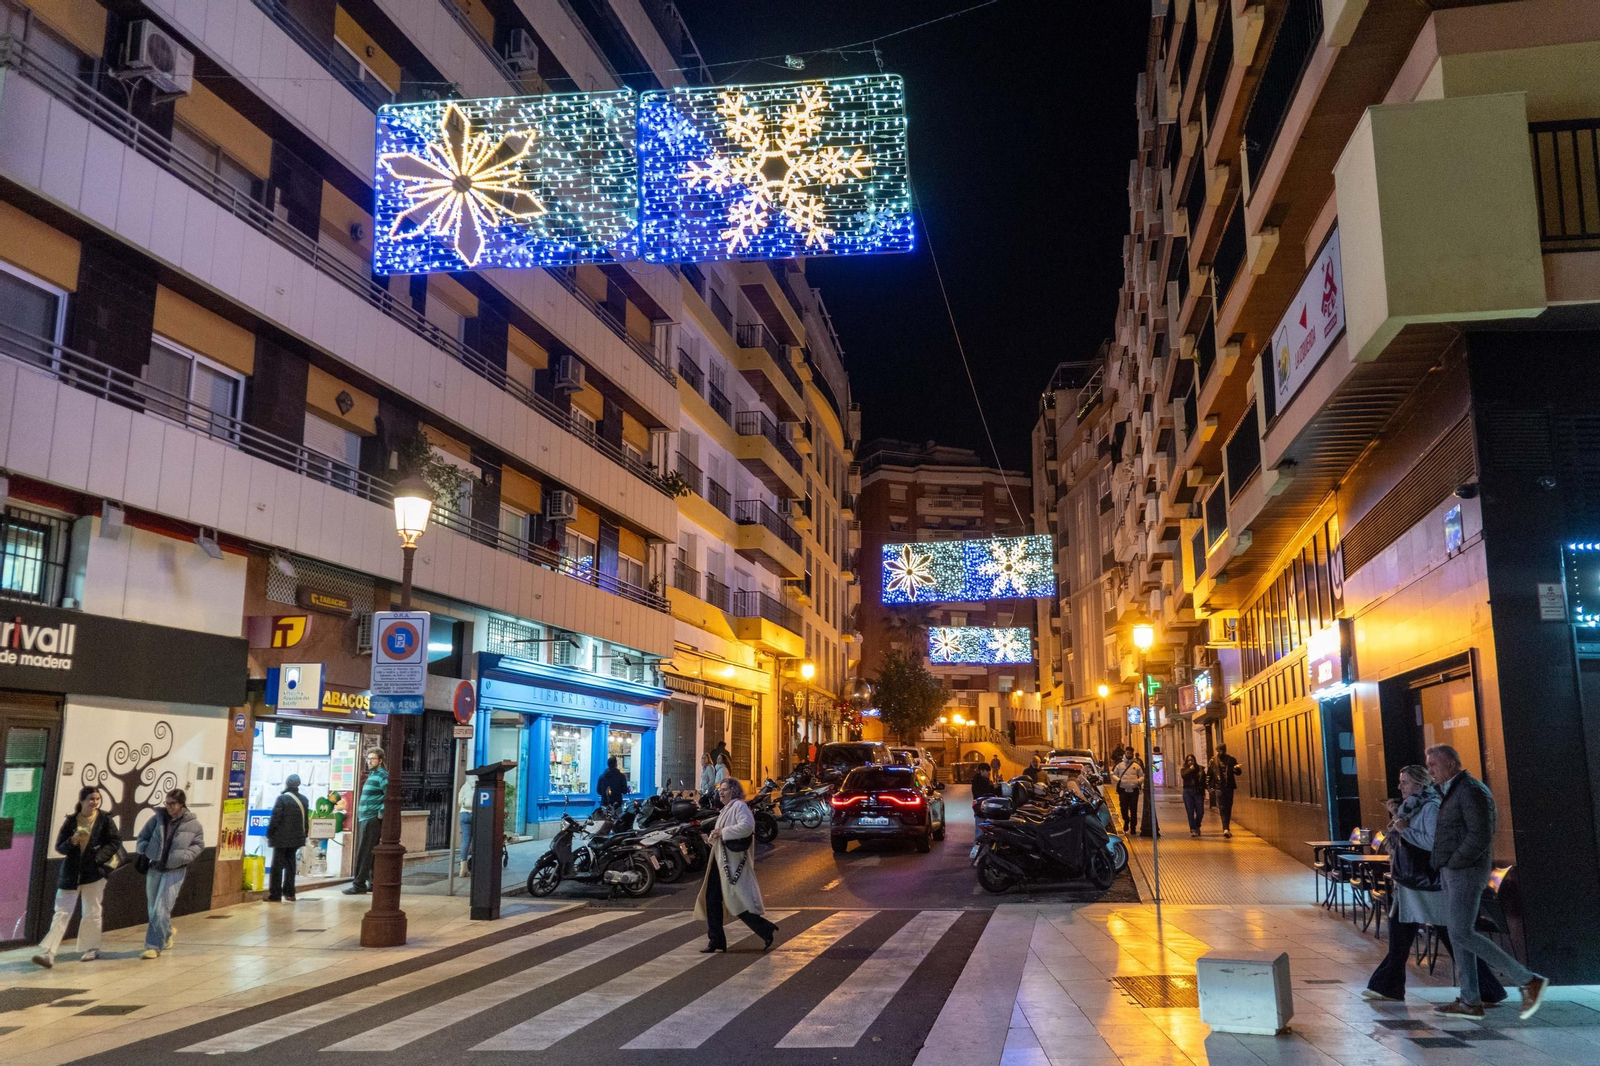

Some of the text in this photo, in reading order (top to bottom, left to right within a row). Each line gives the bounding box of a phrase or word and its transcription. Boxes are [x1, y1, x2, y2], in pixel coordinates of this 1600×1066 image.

[319, 595, 348, 608] TABACOS
[0, 650, 72, 670] de madera
[398, 700, 420, 709] AZUL
[480, 792, 490, 805] P
